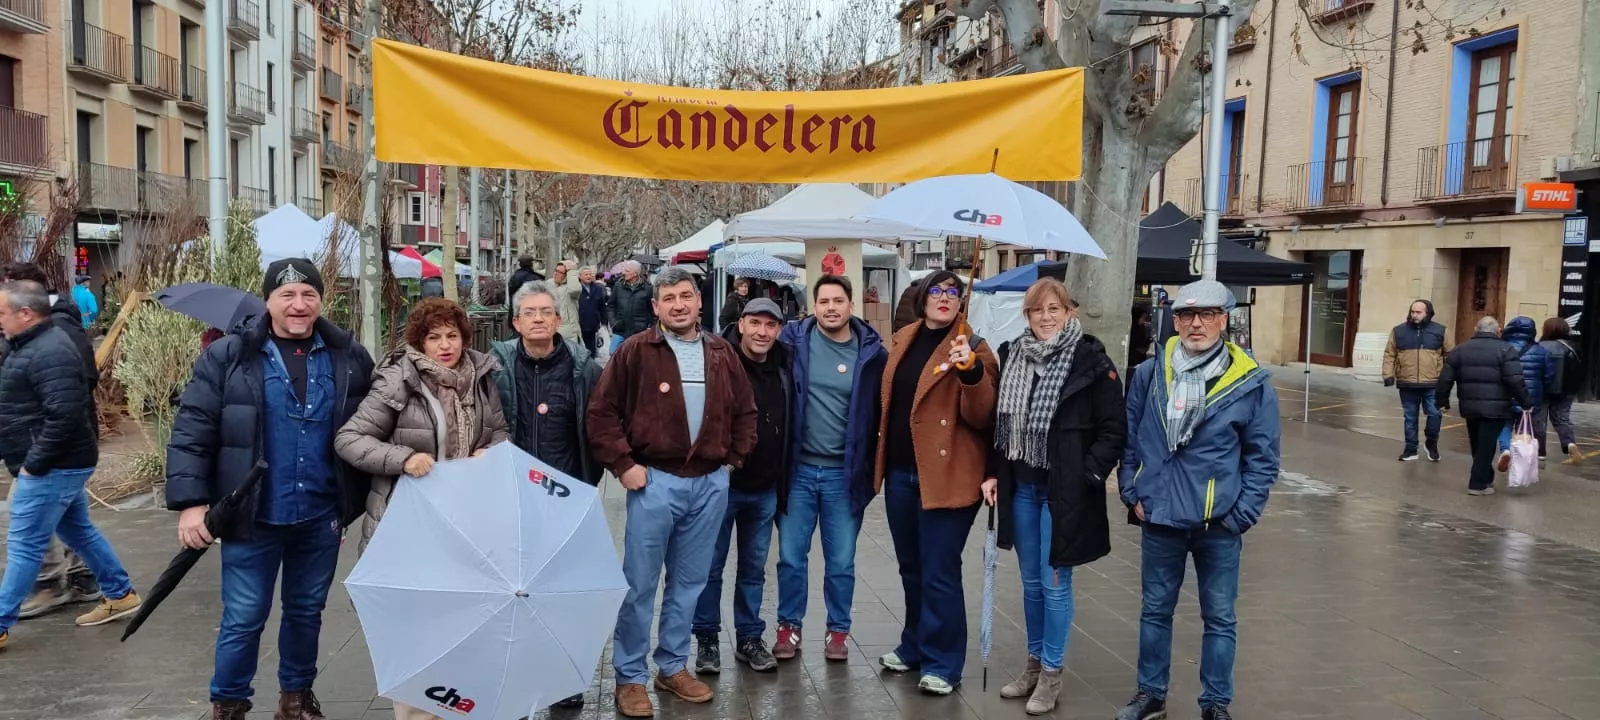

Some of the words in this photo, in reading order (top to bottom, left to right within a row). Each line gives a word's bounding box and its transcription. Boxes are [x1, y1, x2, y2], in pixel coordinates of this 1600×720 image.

[603, 97, 876, 153] Candelera
[1532, 189, 1570, 202] STIHL
[953, 209, 1002, 226] cha
[528, 468, 571, 498] cha
[425, 686, 475, 713] cha
